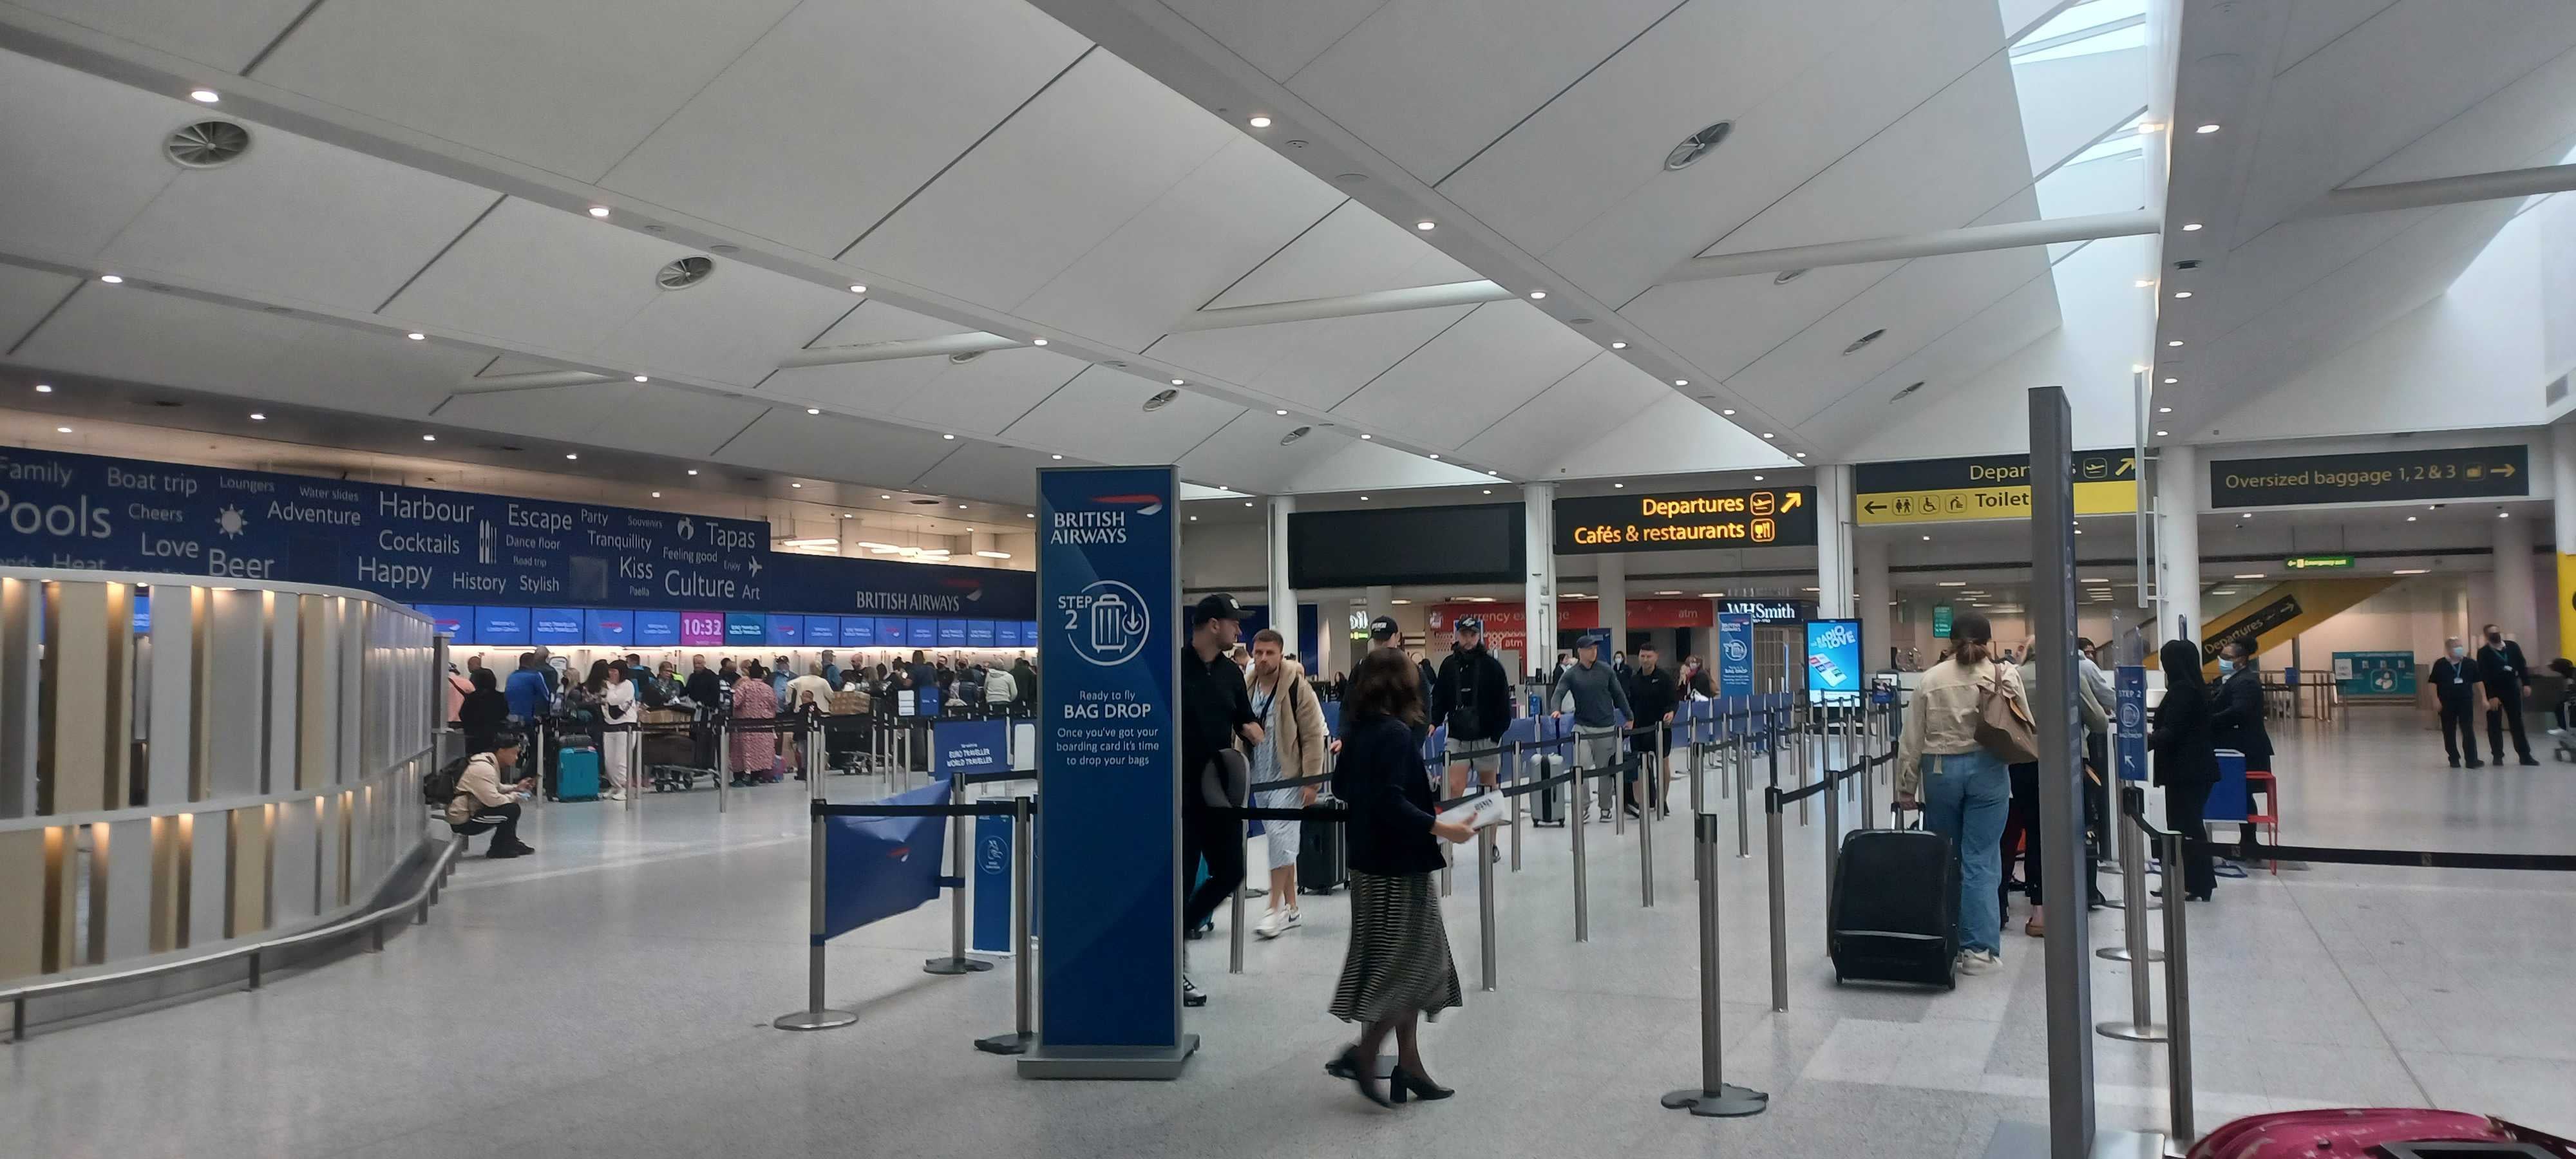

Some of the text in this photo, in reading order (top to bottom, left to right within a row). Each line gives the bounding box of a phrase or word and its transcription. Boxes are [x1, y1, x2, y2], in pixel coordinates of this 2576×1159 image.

[108, 466, 198, 497] Boat trip
[220, 476, 274, 494] Loungers
[2226, 465, 2456, 489] Oversized baggage 1, 2 & 3
[299, 485, 359, 502] Water slides
[129, 503, 183, 522] Cheers
[267, 500, 361, 526] Adventure
[379, 491, 474, 523] Harbour
[1643, 498, 1744, 518] Departures
[508, 504, 572, 534] Escape
[581, 509, 608, 526] Party
[627, 515, 663, 529] Souvenirs
[1054, 511, 1124, 527] BRITISH
[379, 529, 460, 554] Cocktails
[506, 534, 560, 551] Dance floor
[587, 530, 652, 552] Tranquillity
[706, 522, 755, 552] Tapas
[1051, 528, 1127, 545] AIRWAYS
[1574, 523, 1745, 544] Cafés & restaurants
[141, 532, 199, 558] Love
[53, 552, 106, 570] Heat
[209, 549, 275, 579] Beer
[513, 556, 547, 568] Road trip
[663, 546, 717, 565] Feeling good
[358, 556, 432, 589] Happy
[620, 556, 653, 580] Kiss
[724, 560, 741, 572] Enjoy
[453, 572, 506, 594] History
[520, 574, 560, 594] Stylish
[629, 585, 650, 598] Paella
[665, 570, 735, 598] Culture
[742, 584, 760, 601] Art
[857, 590, 960, 612] BRITISH AIRWAYS
[1058, 595, 1092, 609] STEP
[1065, 609, 1077, 630] 2
[1678, 610, 1698, 618] atm
[1727, 603, 1795, 619] WHSmith
[684, 619, 721, 636] 10:32
[2204, 619, 2264, 654] Departures
[1080, 690, 1135, 702] Ready to fly
[1064, 703, 1151, 719] BAG DROP
[1057, 727, 1158, 739] Once you've got your
[1056, 741, 1159, 753] boarding card it's time
[1079, 755, 1101, 768] drop
[1104, 757, 1125, 766] your
[1128, 755, 1149, 766] bags
